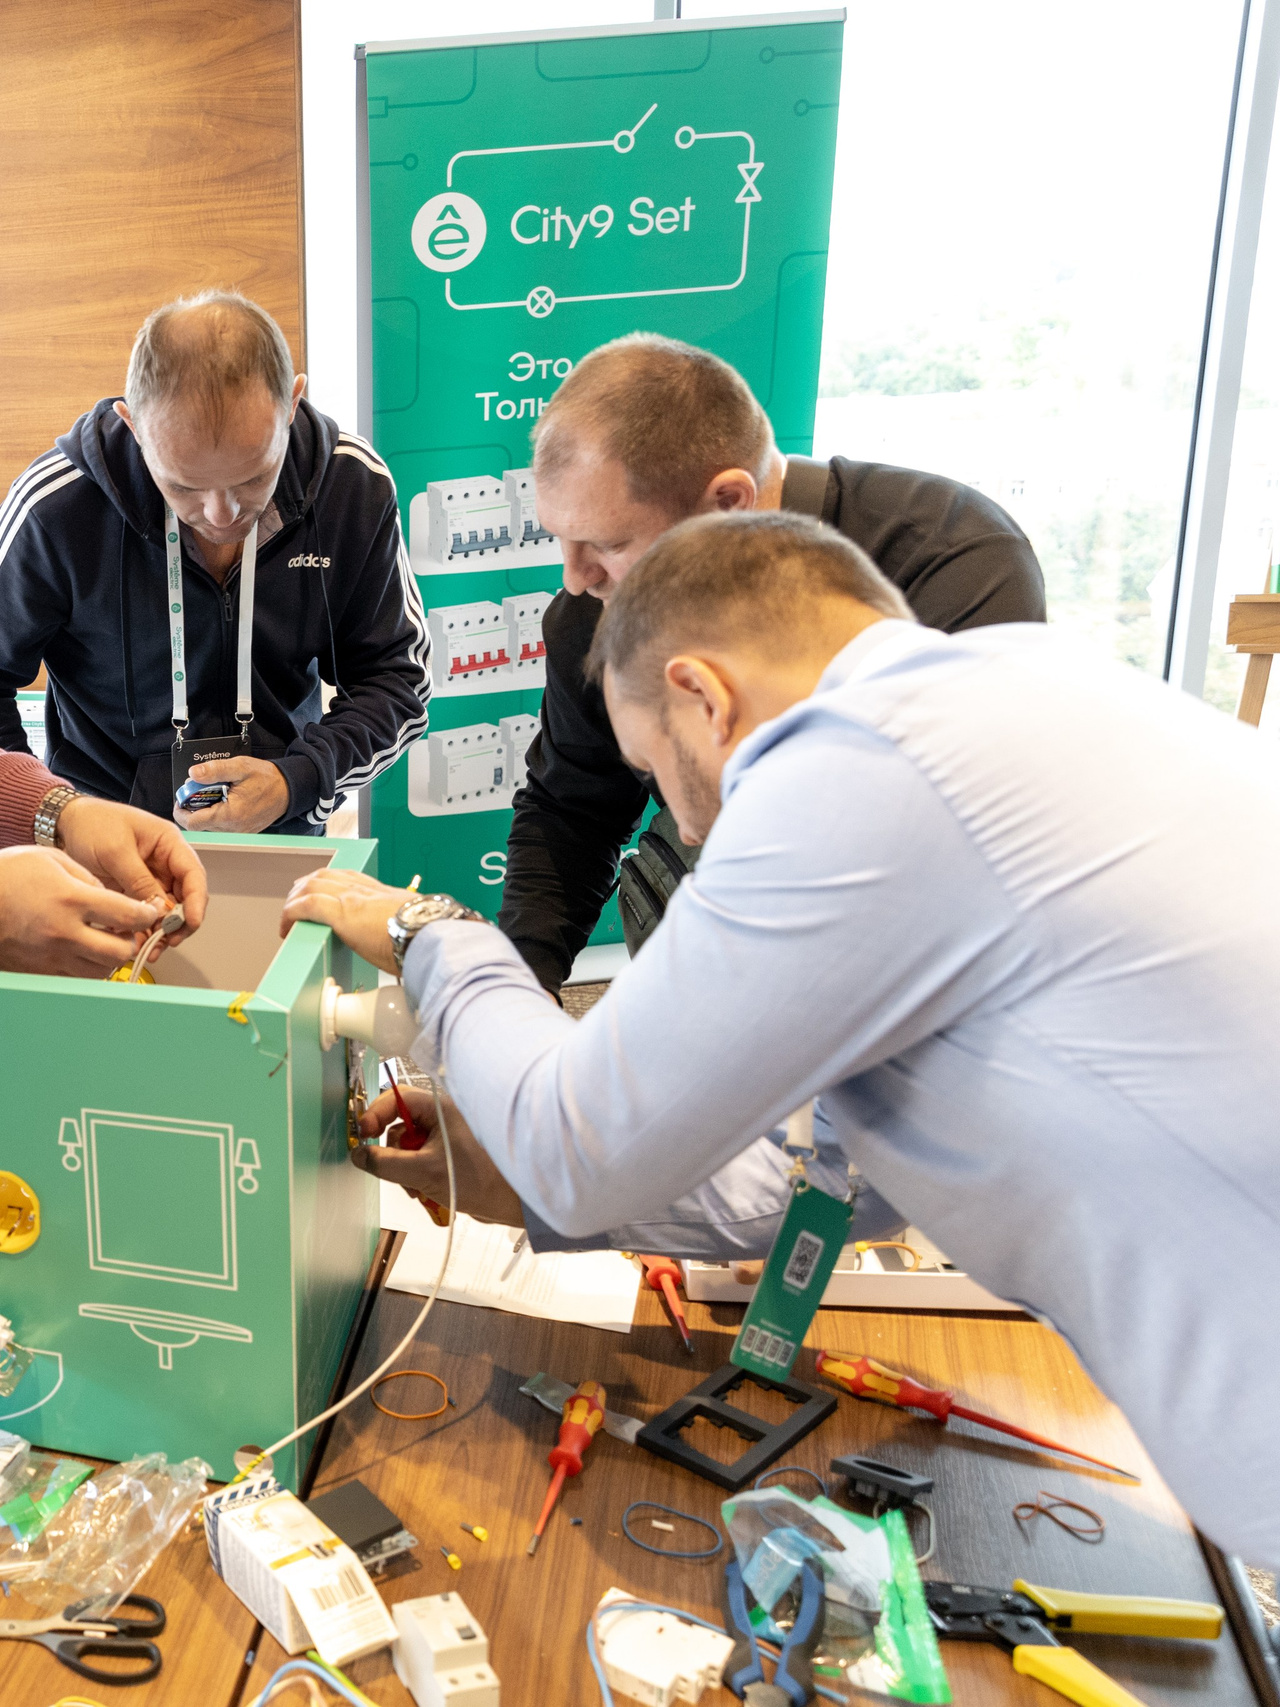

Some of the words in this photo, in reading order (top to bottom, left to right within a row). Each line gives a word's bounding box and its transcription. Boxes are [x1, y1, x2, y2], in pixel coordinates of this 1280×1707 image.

[510, 203, 615, 250] City9
[627, 196, 696, 237] Set
[508, 351, 573, 382] Это
[475, 391, 551, 422] Толь
[288, 553, 331, 569] adidas
[193, 751, 230, 762] Systême
